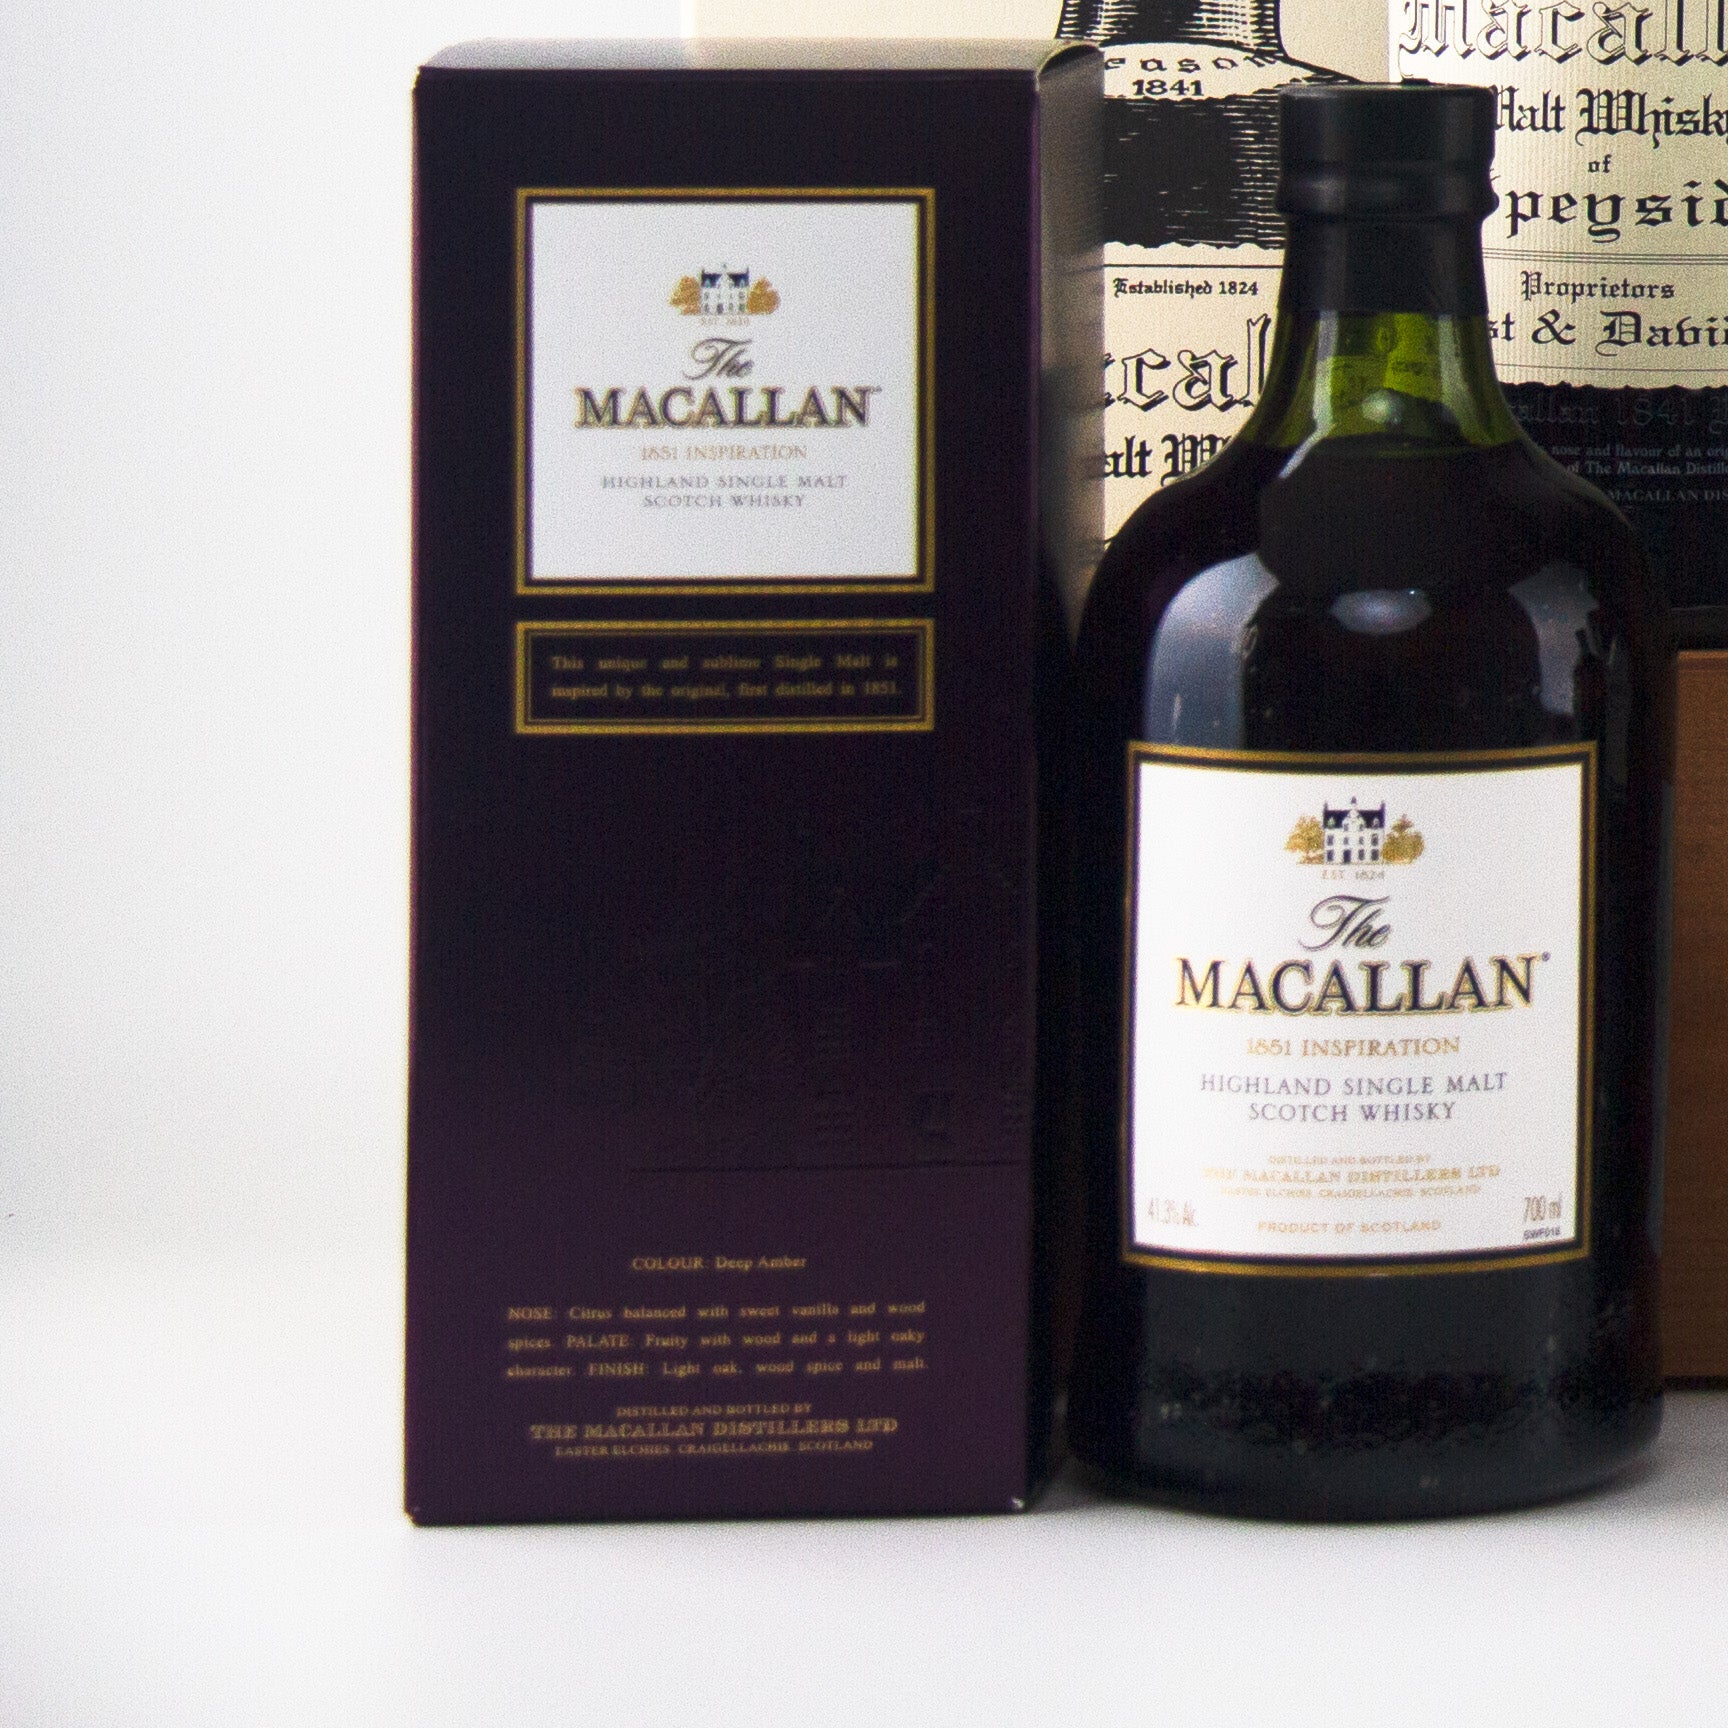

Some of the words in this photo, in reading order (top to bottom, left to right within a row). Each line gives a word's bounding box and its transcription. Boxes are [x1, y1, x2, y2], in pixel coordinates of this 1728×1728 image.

[1132, 79, 1204, 97] 1841
[1588, 153, 1613, 173] of
[1112, 277, 1213, 298] Established
[1218, 278, 1259, 295] 1824
[1520, 270, 1675, 304] Proprietors
[1531, 309, 1578, 345] &
[680, 336, 755, 382] The
[574, 384, 870, 430] MACALLAN
[641, 444, 677, 462] 1851
[685, 443, 808, 462] INSPIRATION
[601, 474, 710, 490] HIGHLAND
[716, 474, 789, 490] SINGLE
[796, 473, 847, 489] MALT
[643, 493, 724, 510] SCOTCH
[730, 493, 808, 510] WHISKY
[1298, 894, 1393, 953] The
[1174, 954, 1539, 1017] MACALLAN
[1245, 1038, 1293, 1056] 1851
[1301, 1035, 1462, 1059] INSPIRATION
[1198, 1073, 1332, 1096] HIGHLAND
[1342, 1074, 1435, 1096] SINGLE
[1445, 1071, 1510, 1094] MALT
[1248, 1102, 1349, 1124] SCOTCH
[1358, 1100, 1458, 1123] WHISKY
